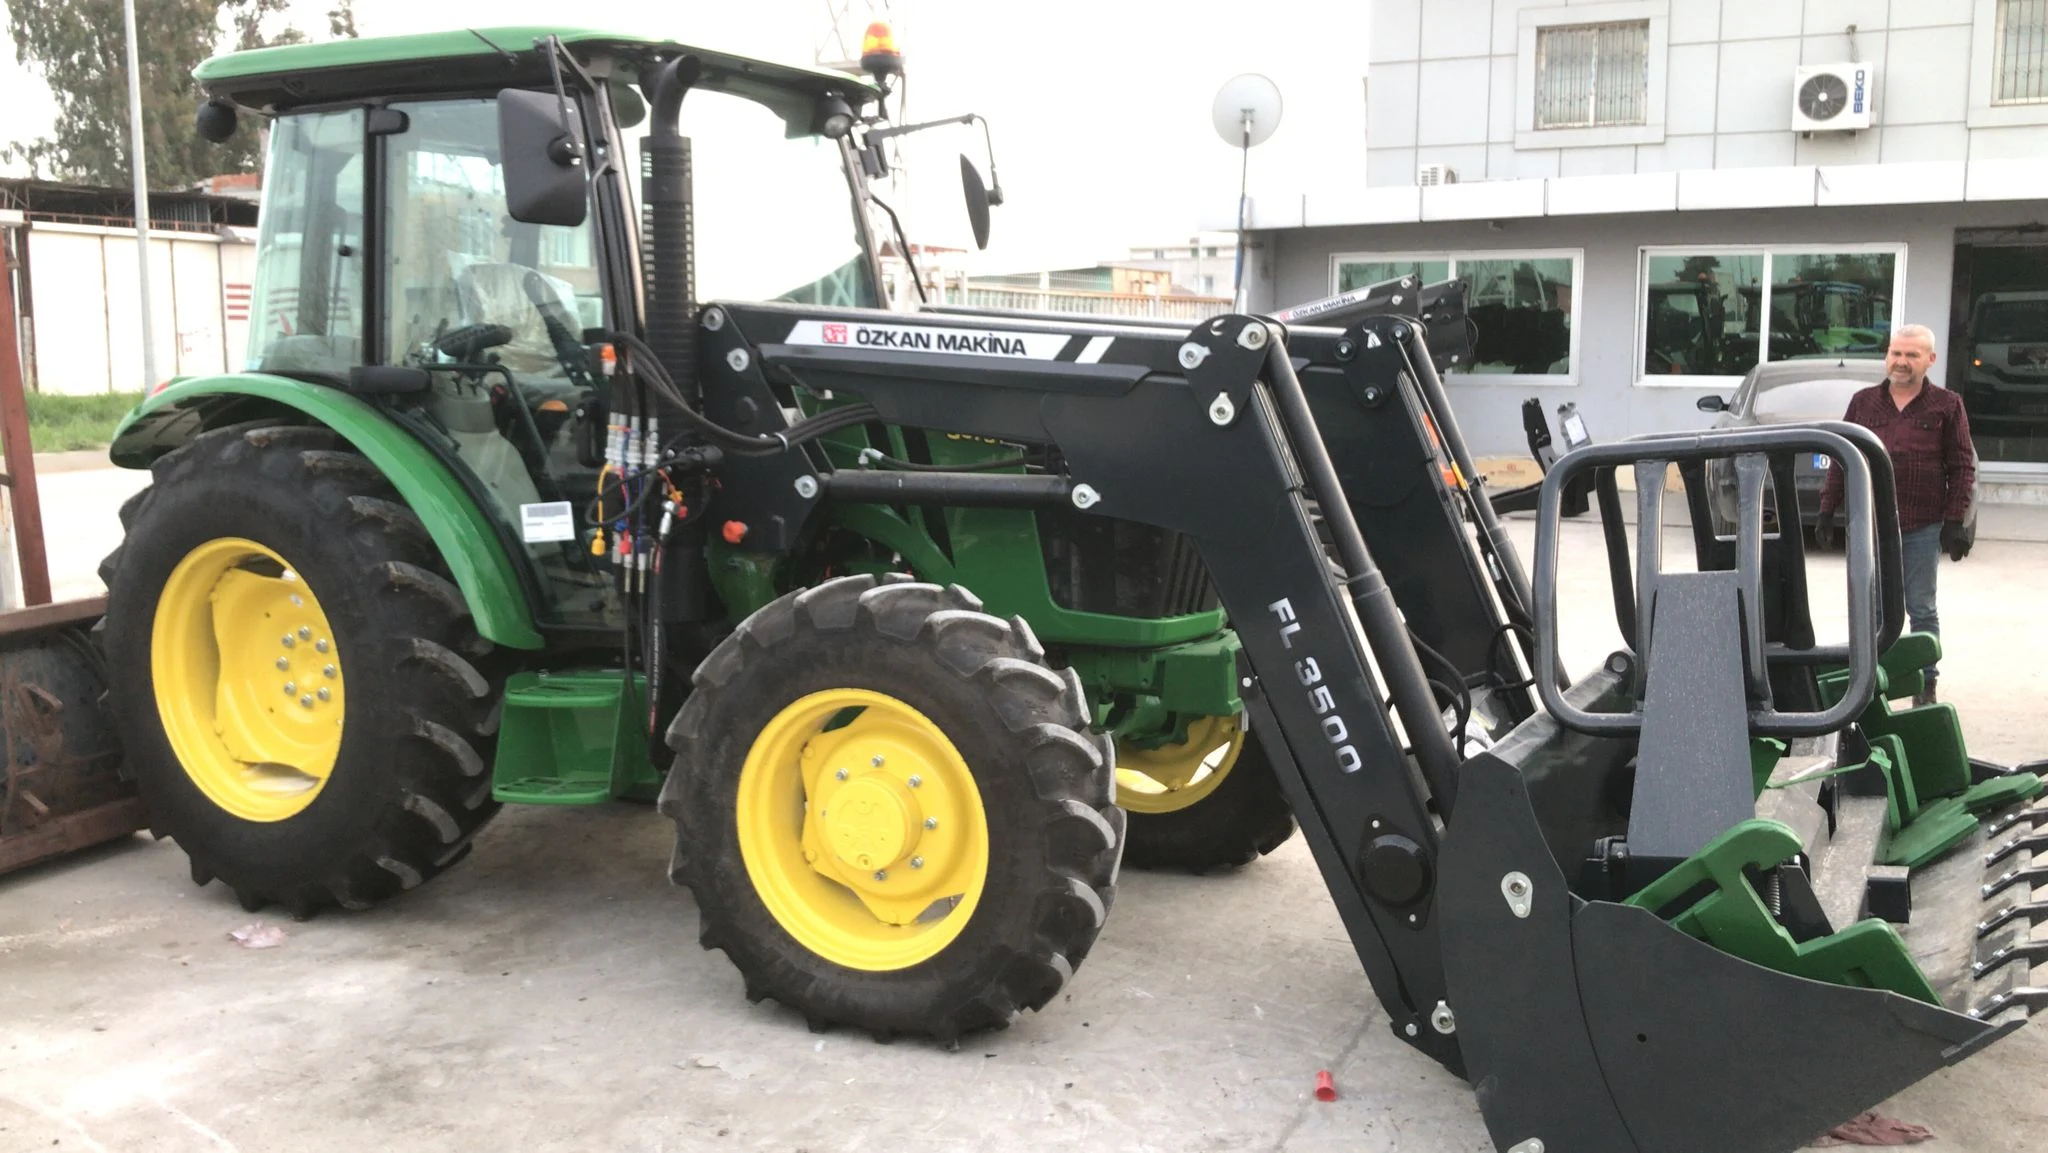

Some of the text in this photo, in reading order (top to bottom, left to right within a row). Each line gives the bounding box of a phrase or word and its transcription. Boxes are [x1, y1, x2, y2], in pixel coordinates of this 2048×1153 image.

[1853, 69, 1865, 114] BEKO
[856, 327, 931, 349] ÖZKAN
[936, 332, 1027, 356] MAKİNA
[1268, 597, 1362, 774] FL 3500
